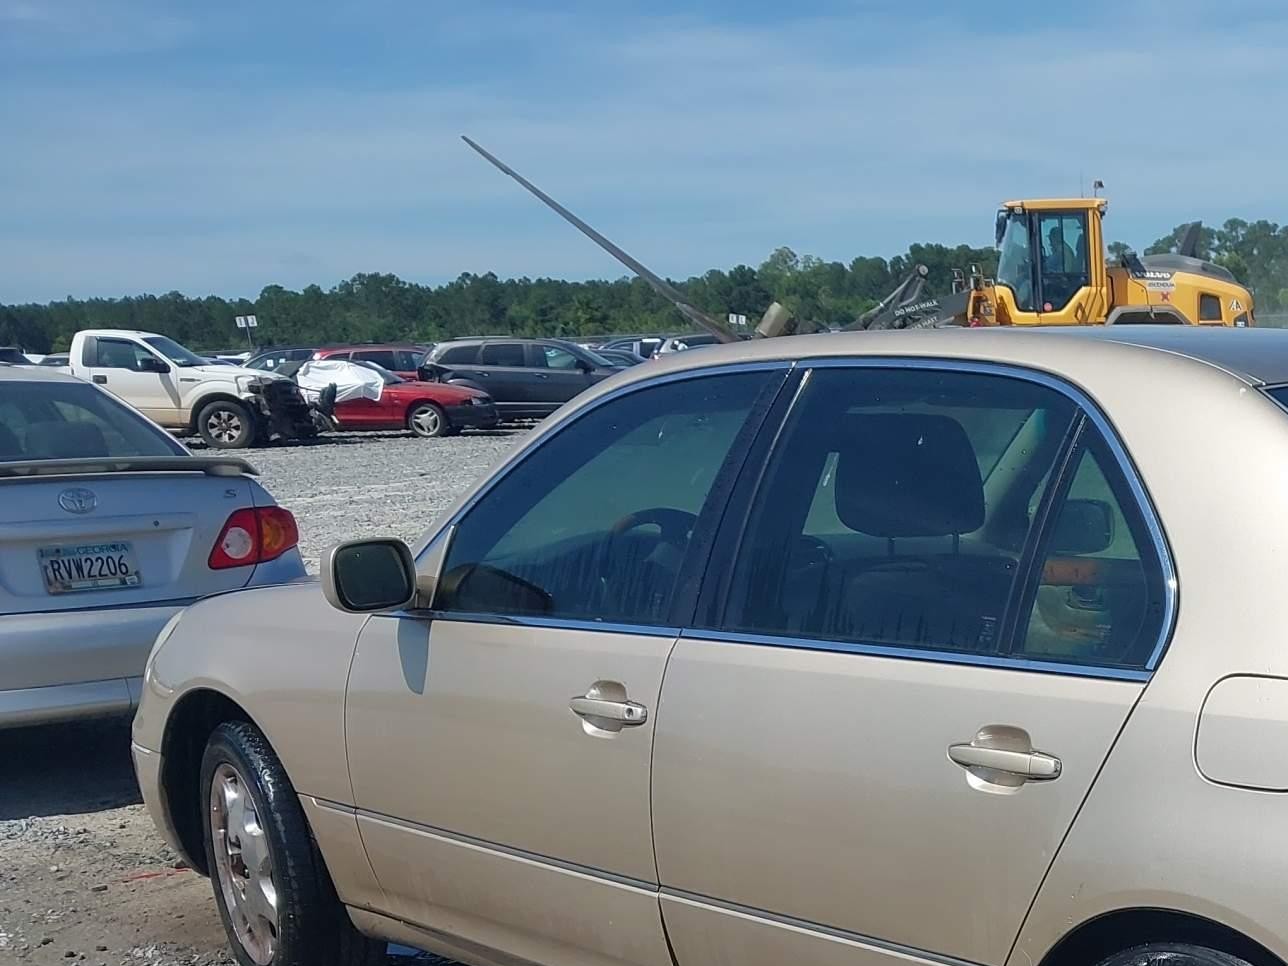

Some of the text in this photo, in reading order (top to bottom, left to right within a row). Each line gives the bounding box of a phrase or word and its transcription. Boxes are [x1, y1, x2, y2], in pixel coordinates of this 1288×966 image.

[1133, 271, 1171, 279] VOLVO
[894, 299, 939, 317] DO NOT WALK
[76, 543, 129, 555] GEORGIA
[50, 555, 129, 581] RVW2206
